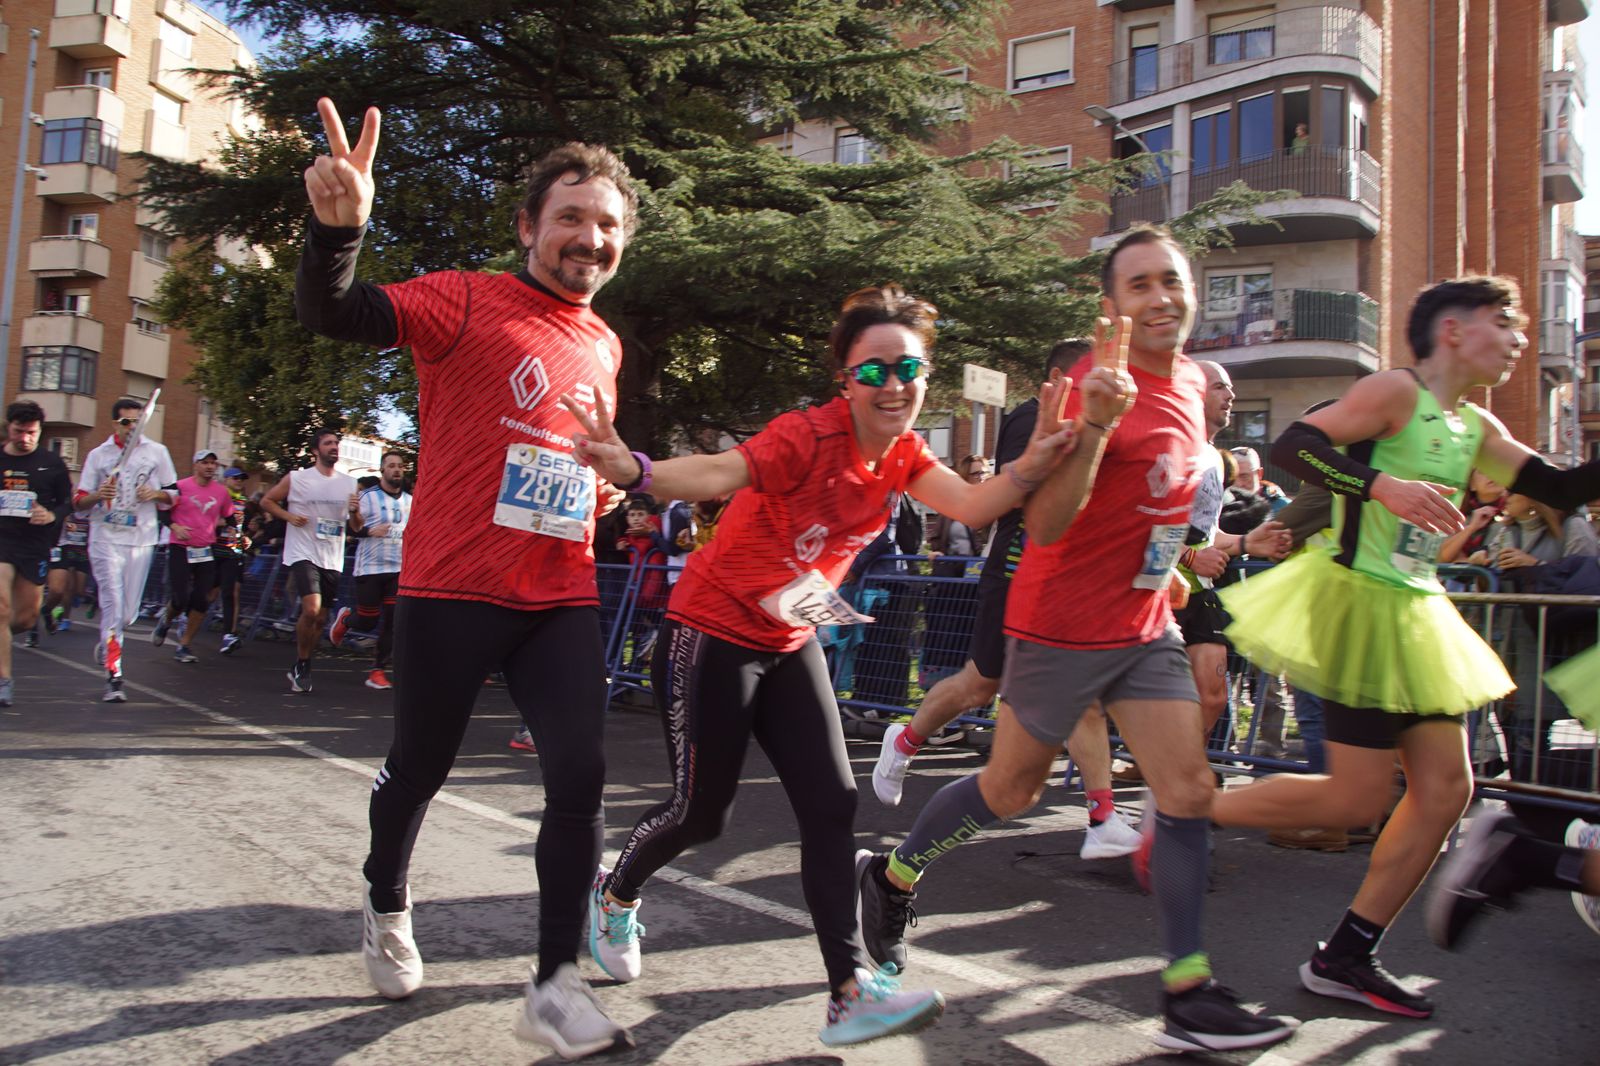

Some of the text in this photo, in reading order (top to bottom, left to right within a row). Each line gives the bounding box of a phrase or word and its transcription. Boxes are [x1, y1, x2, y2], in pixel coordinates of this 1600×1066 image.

[514, 467, 581, 512] 2879
[1297, 449, 1366, 488] CORRECANOS
[673, 626, 693, 698] RUNNING
